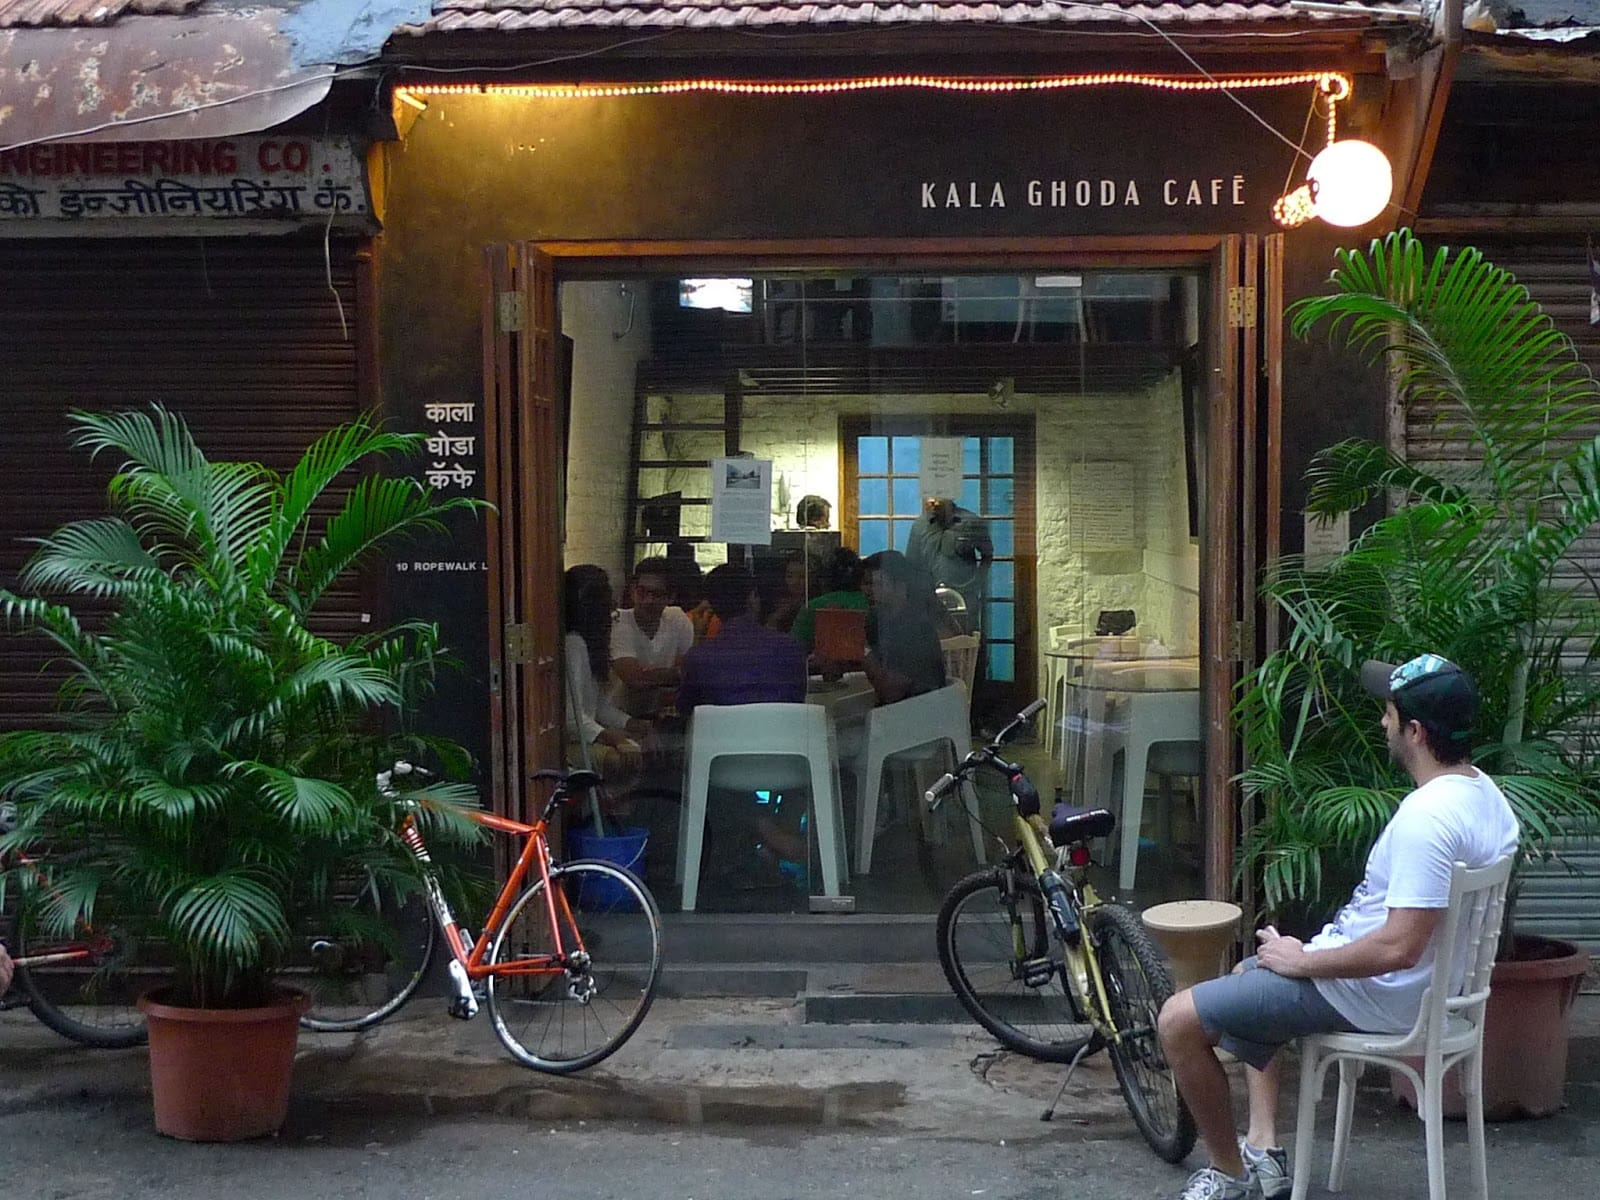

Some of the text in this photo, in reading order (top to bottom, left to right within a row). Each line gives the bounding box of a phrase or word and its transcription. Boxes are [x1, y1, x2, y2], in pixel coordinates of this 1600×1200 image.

[921, 182, 1006, 208] KALA
[1028, 180, 1140, 207] GHODA
[424, 402, 475, 423] काला
[396, 562, 408, 571] 10
[414, 562, 477, 571] ROPEWALK
